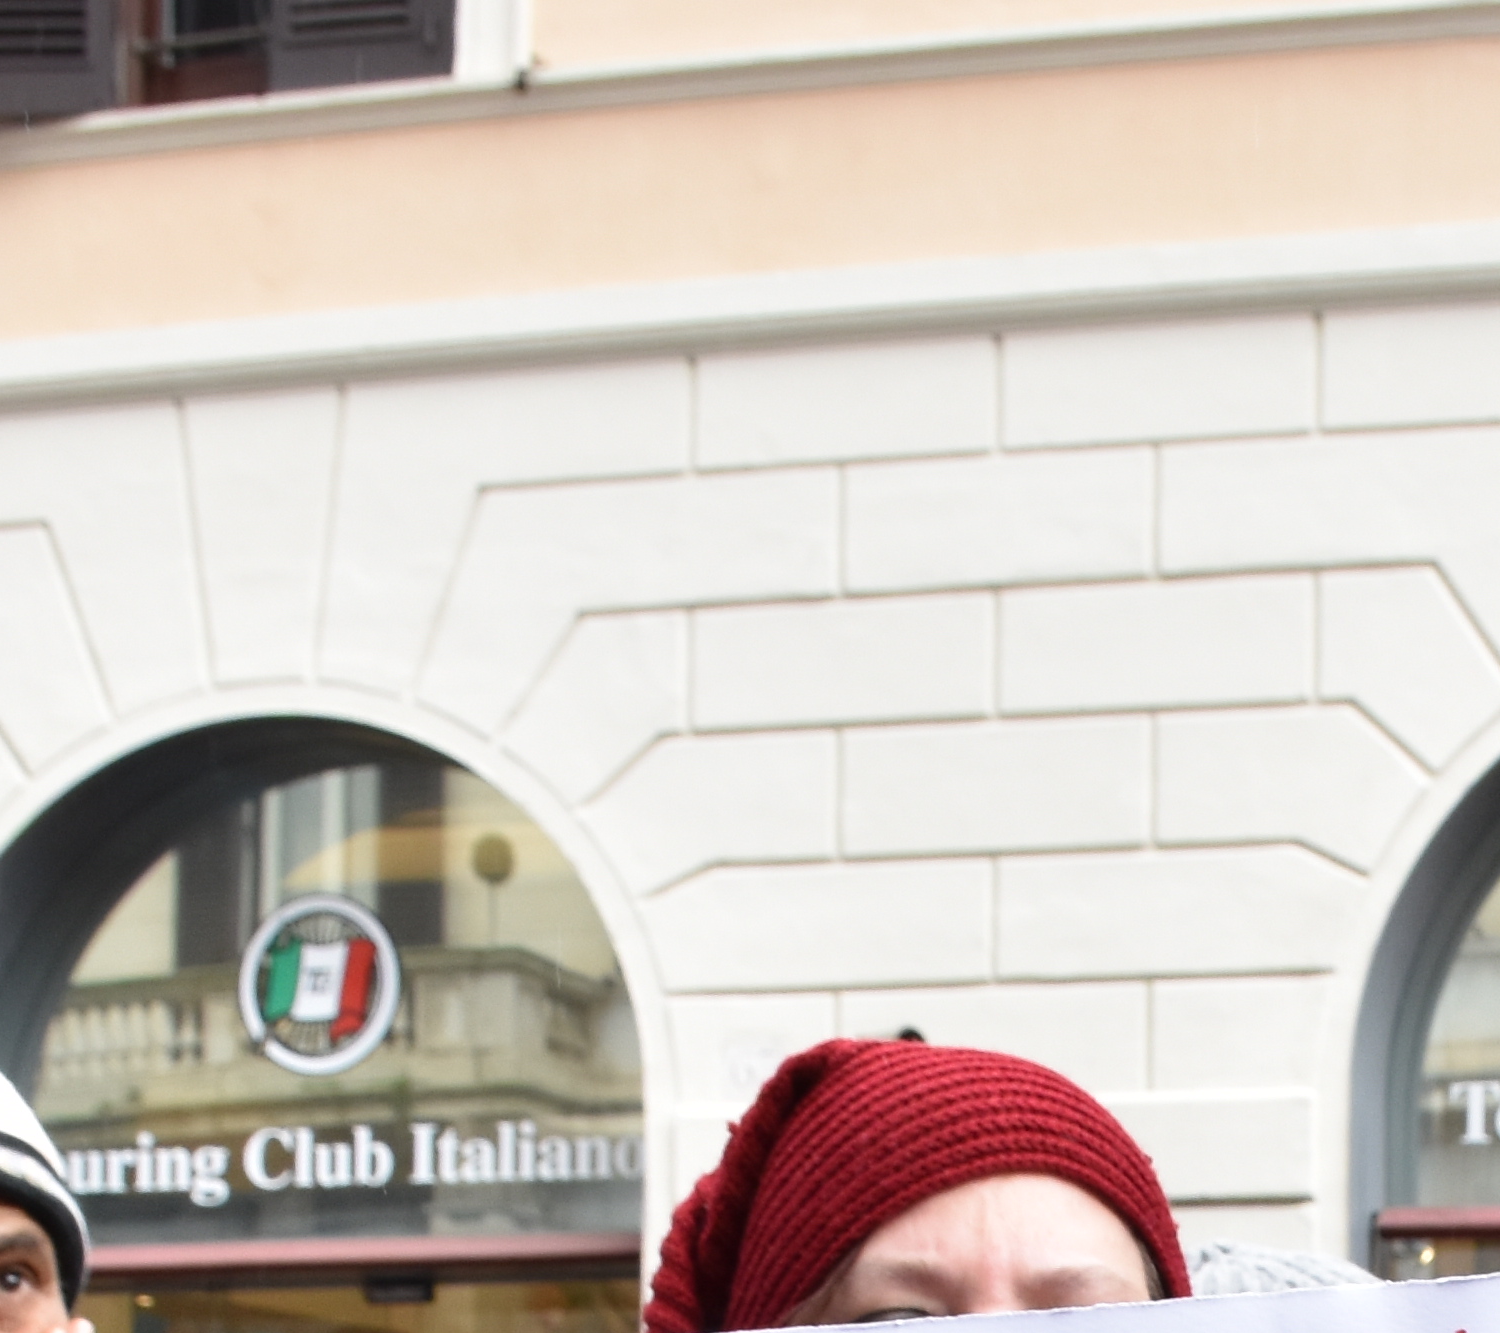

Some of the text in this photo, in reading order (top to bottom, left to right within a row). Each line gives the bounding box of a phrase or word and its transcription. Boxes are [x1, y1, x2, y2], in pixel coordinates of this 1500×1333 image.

[66, 1119, 644, 1208] uring Club Italiano
